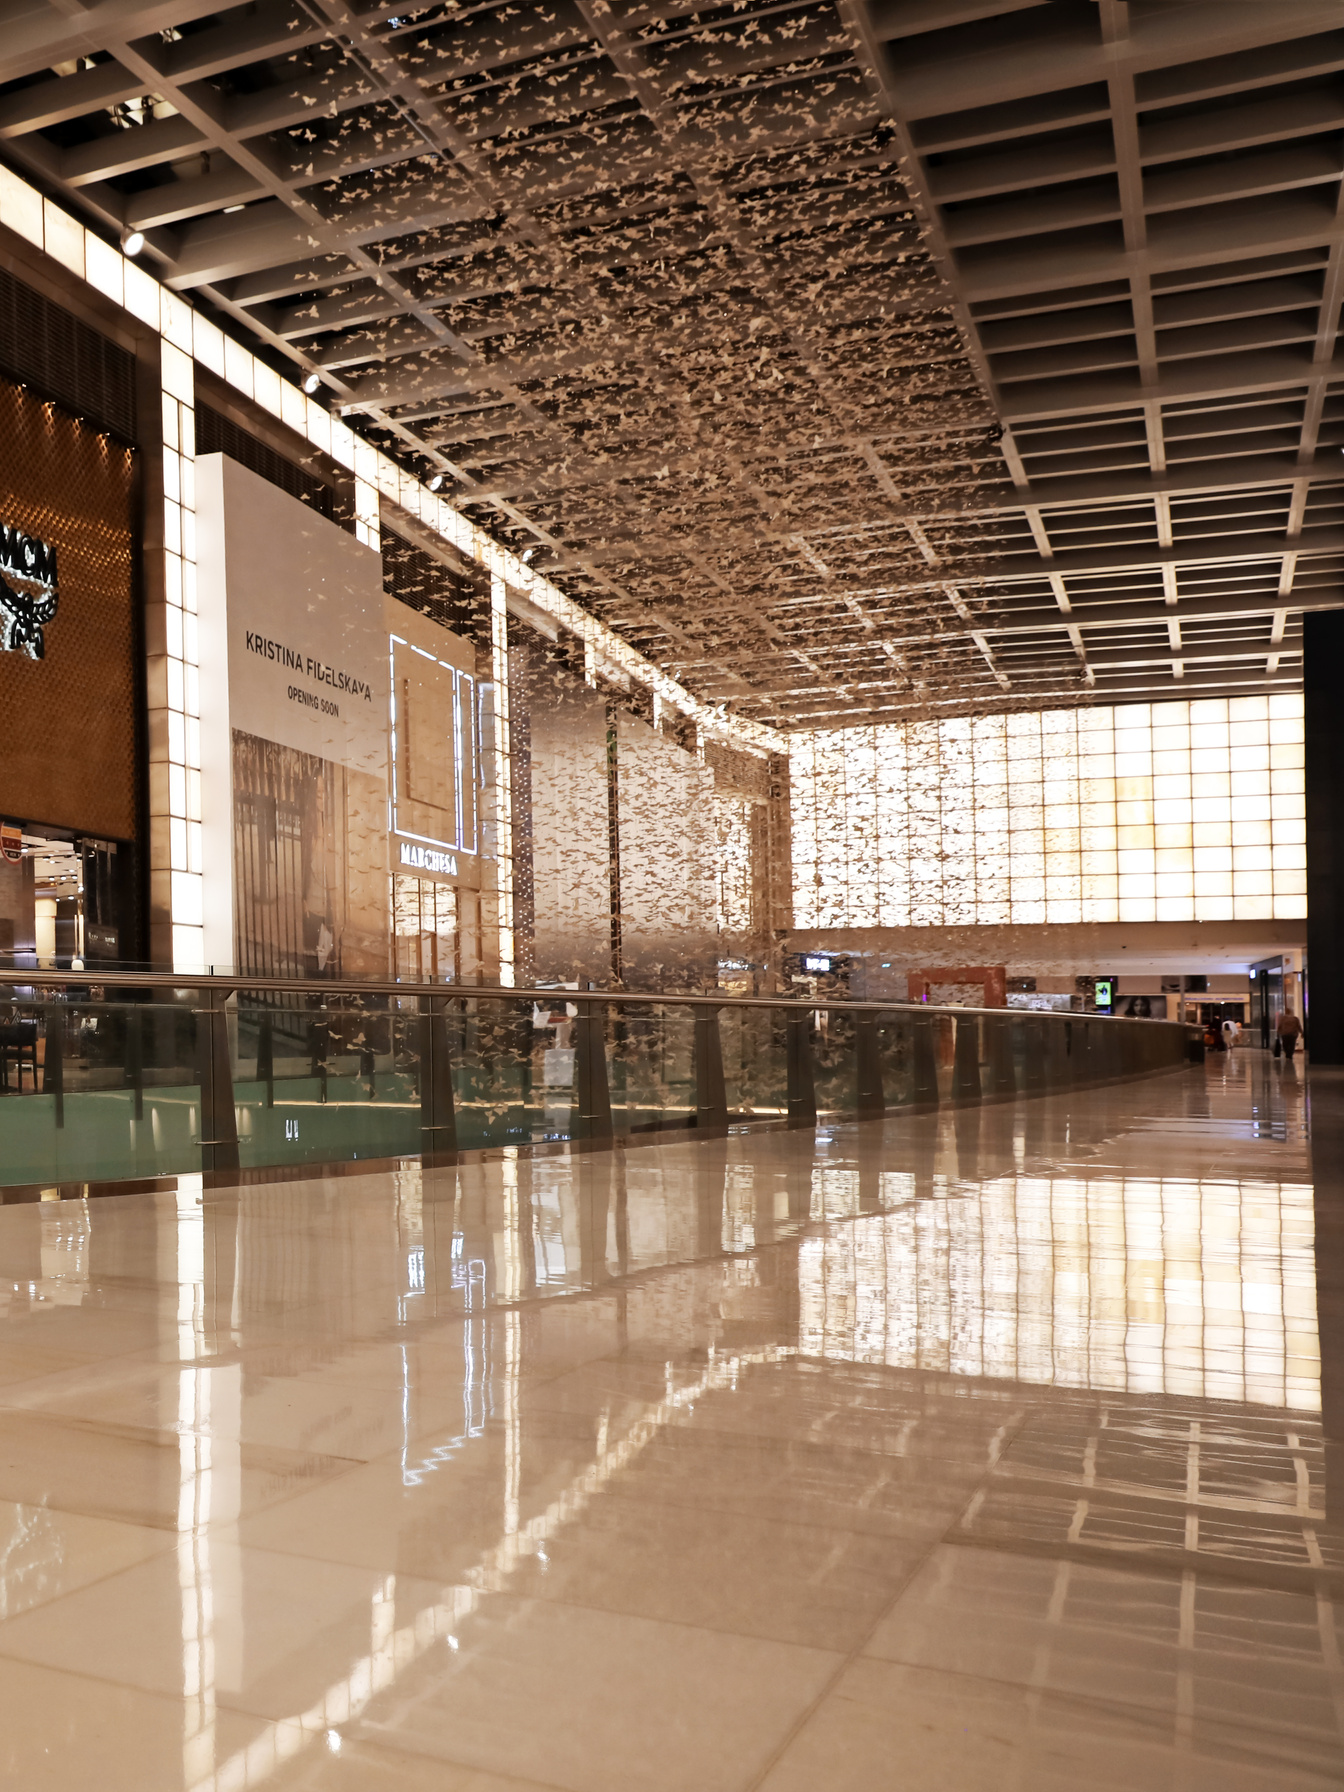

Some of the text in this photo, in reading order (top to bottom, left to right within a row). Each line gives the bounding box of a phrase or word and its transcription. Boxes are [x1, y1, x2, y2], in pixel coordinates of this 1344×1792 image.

[245, 630, 372, 702] KRISTINA FIDELSKAYA
[287, 685, 339, 718] OPENING SOON
[400, 842, 458, 876] MARCHESA
